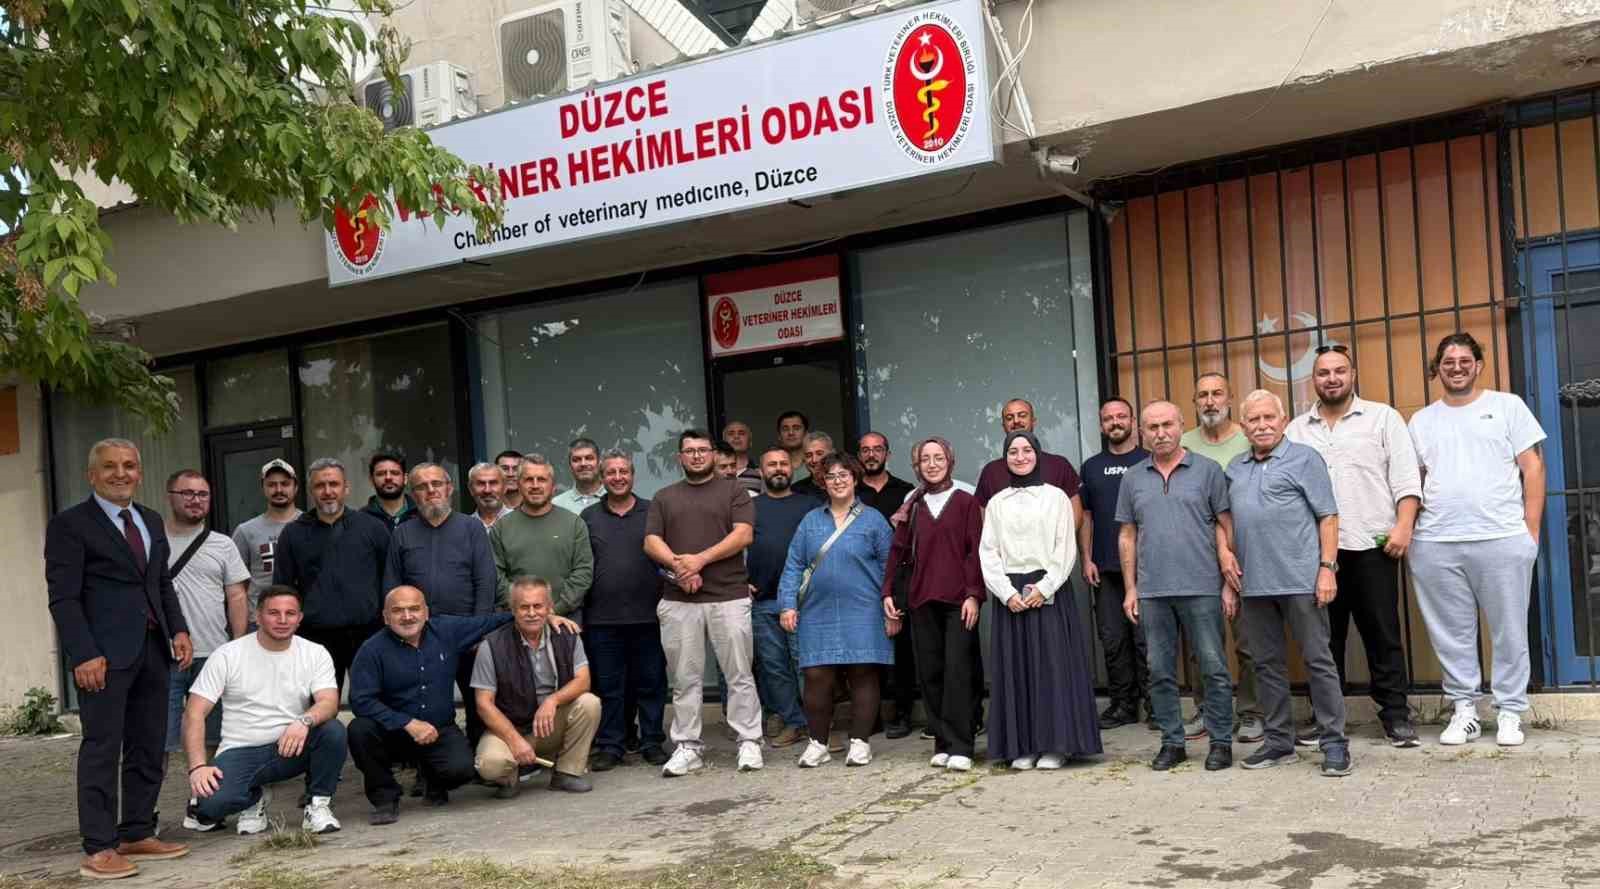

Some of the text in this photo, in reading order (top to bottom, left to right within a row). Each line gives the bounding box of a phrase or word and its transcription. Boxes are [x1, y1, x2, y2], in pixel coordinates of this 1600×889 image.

[560, 80, 669, 139] DÜZCE
[567, 104, 752, 186] HEKİMLERİ
[761, 86, 874, 145] ODASI
[534, 213, 551, 233] of
[558, 202, 648, 229] veterinary
[755, 166, 818, 191] Düzce
[774, 290, 803, 305] DÜZCE
[791, 302, 838, 320] HEKİMLERİ
[777, 326, 803, 340] ODASI
